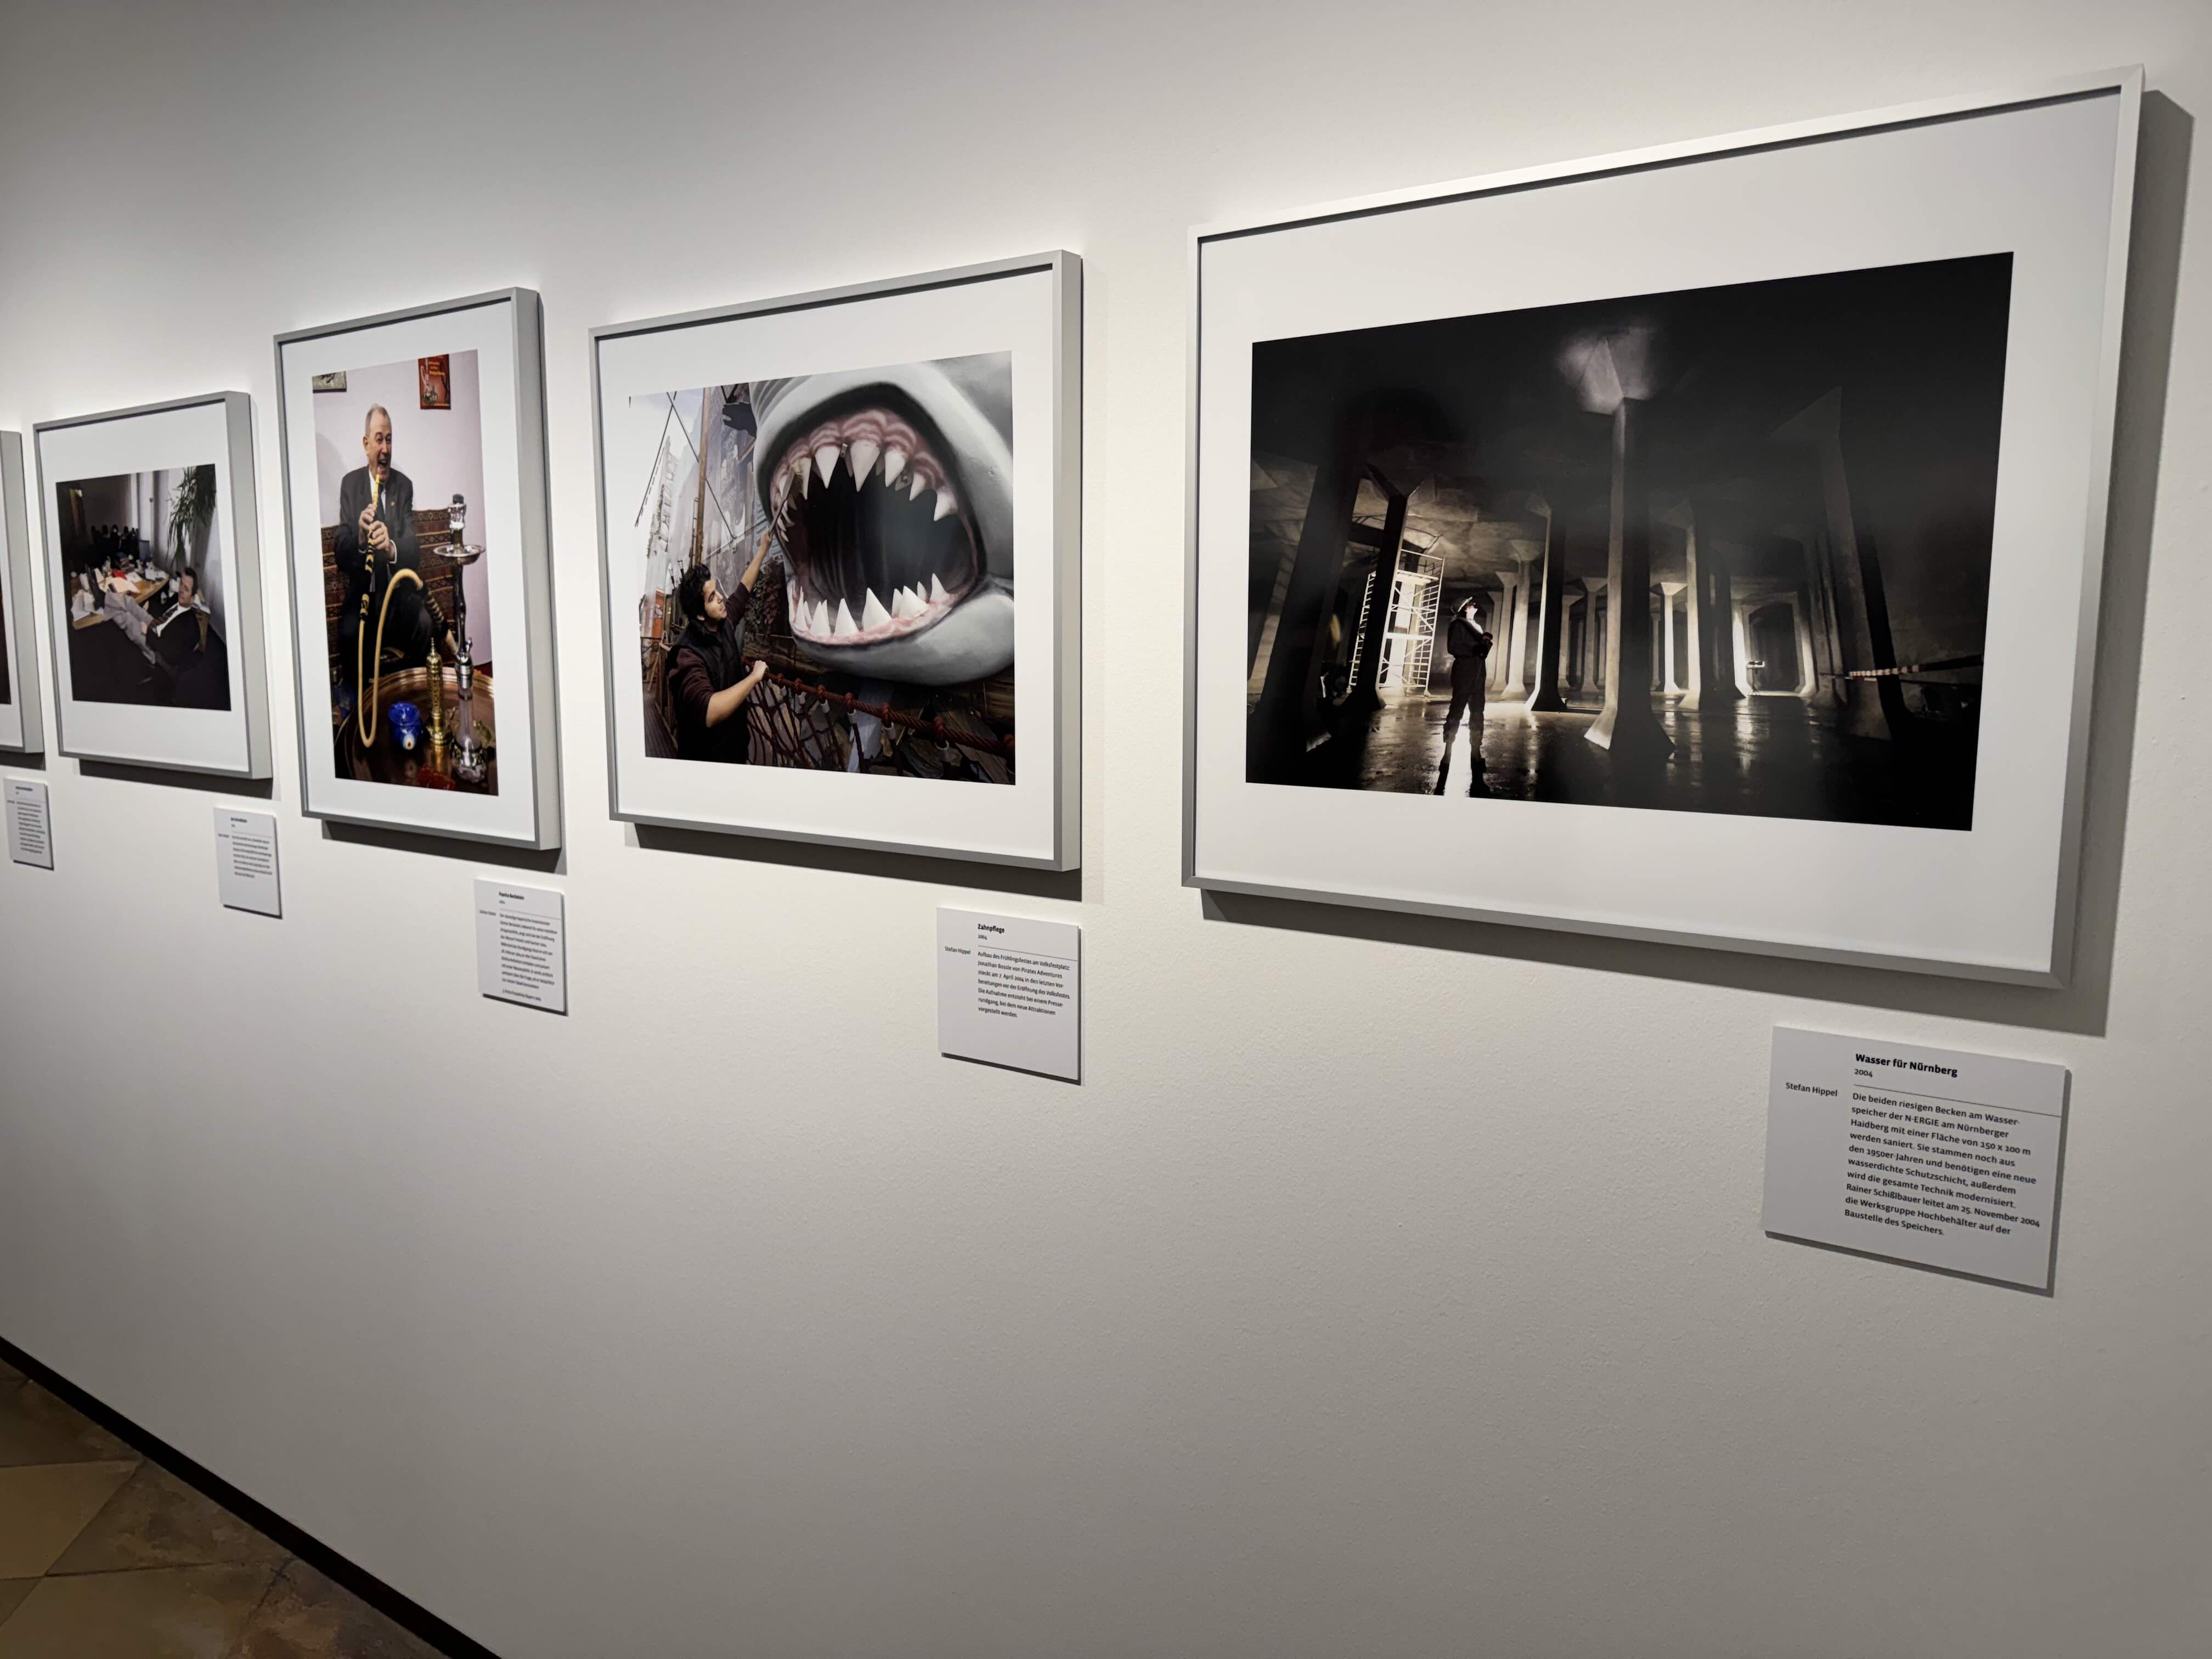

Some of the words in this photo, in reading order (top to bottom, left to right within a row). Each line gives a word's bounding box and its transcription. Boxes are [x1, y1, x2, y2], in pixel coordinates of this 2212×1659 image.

[978, 923, 1005, 934] Zahnpflege
[1854, 1068, 1873, 1077] 2004
[1855, 1053, 1891, 1066] Wasser
[1892, 1058, 1908, 1068] für
[1909, 1062, 1957, 1078] Nürnberg
[1786, 1082, 1810, 1092] Stefan
[1812, 1086, 1837, 1097] Hippel
[1852, 1092, 1866, 1101] Die
[1868, 1094, 1897, 1106] beiden
[1899, 1100, 1933, 1112] riesigen
[1935, 1105, 1966, 1117] Becken
[1850, 1119, 1888, 1133] Haidberg
[1890, 1126, 1905, 1135] mit
[1907, 1128, 1929, 1138] einer
[1931, 1132, 1960, 1143] Fläche
[1961, 1138, 1979, 1147] von
[1980, 1141, 1995, 1149] 150
[2005, 1146, 2021, 1154] 100
[1852, 1107, 1887, 1118] speicher
[1888, 1111, 1903, 1120] der
[1904, 1114, 1939, 1126] N-ERGIE
[1957, 1123, 2009, 1138] Nürnberger
[1849, 1133, 1881, 1143] werden
[1917, 1143, 1929, 1152] Sie
[1931, 1146, 1973, 1159] stammen
[1974, 1154, 1997, 1163] noch
[1999, 1158, 2015, 1166] aus
[1848, 1144, 1864, 1154] den
[1925, 1159, 1943, 1167] und
[1944, 1160, 1989, 1176] benötigen
[1991, 1170, 2011, 1180] eine
[2013, 1175, 2036, 1184] neue
[1848, 1158, 1904, 1174] wasserdichte
[1905, 1167, 1968, 1187] Schutzschicht,
[1970, 1181, 2016, 1194] außerdem
[1847, 1171, 1865, 1180] wird
[1867, 1174, 1881, 1183] die
[1882, 1178, 1918, 1190] gesamte
[1920, 1183, 1954, 1197] Technik
[1844, 1209, 1883, 1222] Baustelle
[1884, 1216, 1899, 1226] des
[1845, 1195, 1858, 1205] die
[1860, 1198, 1916, 1216] Werksgruppe
[1917, 1210, 1977, 1228] Hochbehälter
[1995, 1224, 2011, 1234] der
[1846, 1183, 1872, 1194] Rainer
[1922, 1197, 1944, 1208] leitet
[1974, 1207, 2018, 1222] November
[2020, 1217, 2040, 1227] 2004
